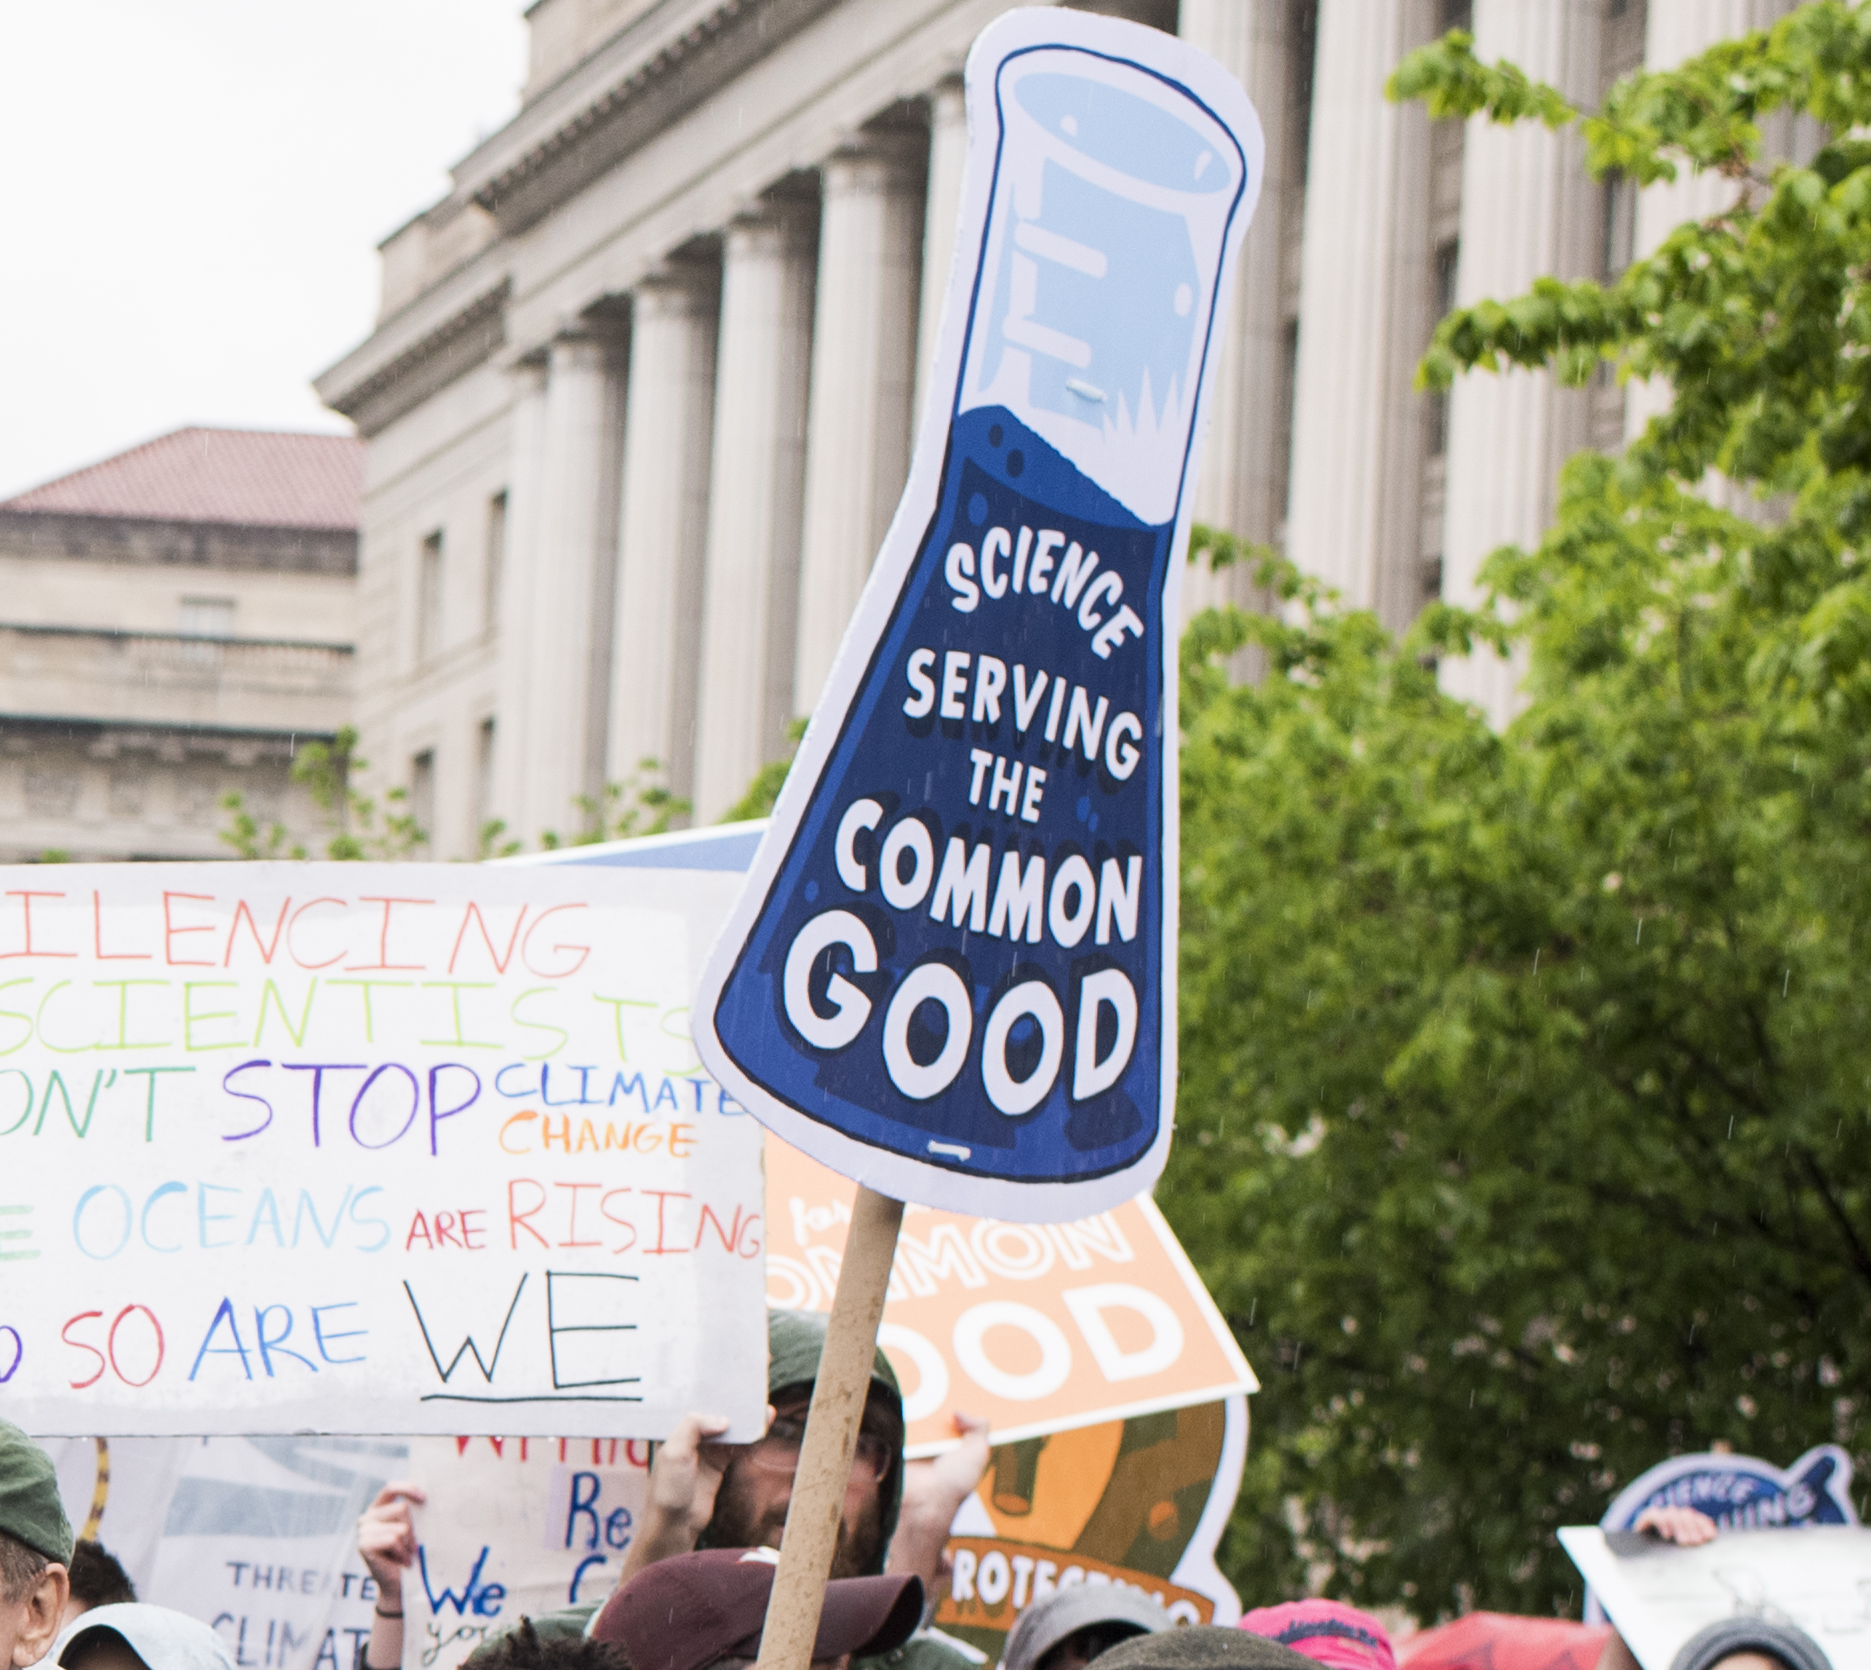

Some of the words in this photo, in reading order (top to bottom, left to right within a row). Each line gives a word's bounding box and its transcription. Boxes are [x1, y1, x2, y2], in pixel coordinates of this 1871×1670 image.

[945, 526, 1144, 660] SCIENCE
[903, 646, 1143, 780] SERVING
[968, 747, 1047, 824] THE
[835, 797, 1141, 948] COMMON
[784, 908, 1136, 1116] GOOD
[220, 1059, 481, 1157] STOP
[493, 1063, 746, 1117] CLIMATE
[499, 1109, 700, 1158] CHANGE
[72, 1180, 392, 1262] OCEANS
[404, 1209, 489, 1252] ARE
[506, 1177, 763, 1259] RISING
[766, 1219, 1135, 1312] OMMON
[62, 1304, 166, 1389] SO
[188, 1295, 370, 1383] ARE
[403, 1270, 641, 1391] WE
[875, 1282, 1184, 1422] OOD
[226, 1561, 379, 1601] THRETE
[418, 1544, 507, 1618] We
